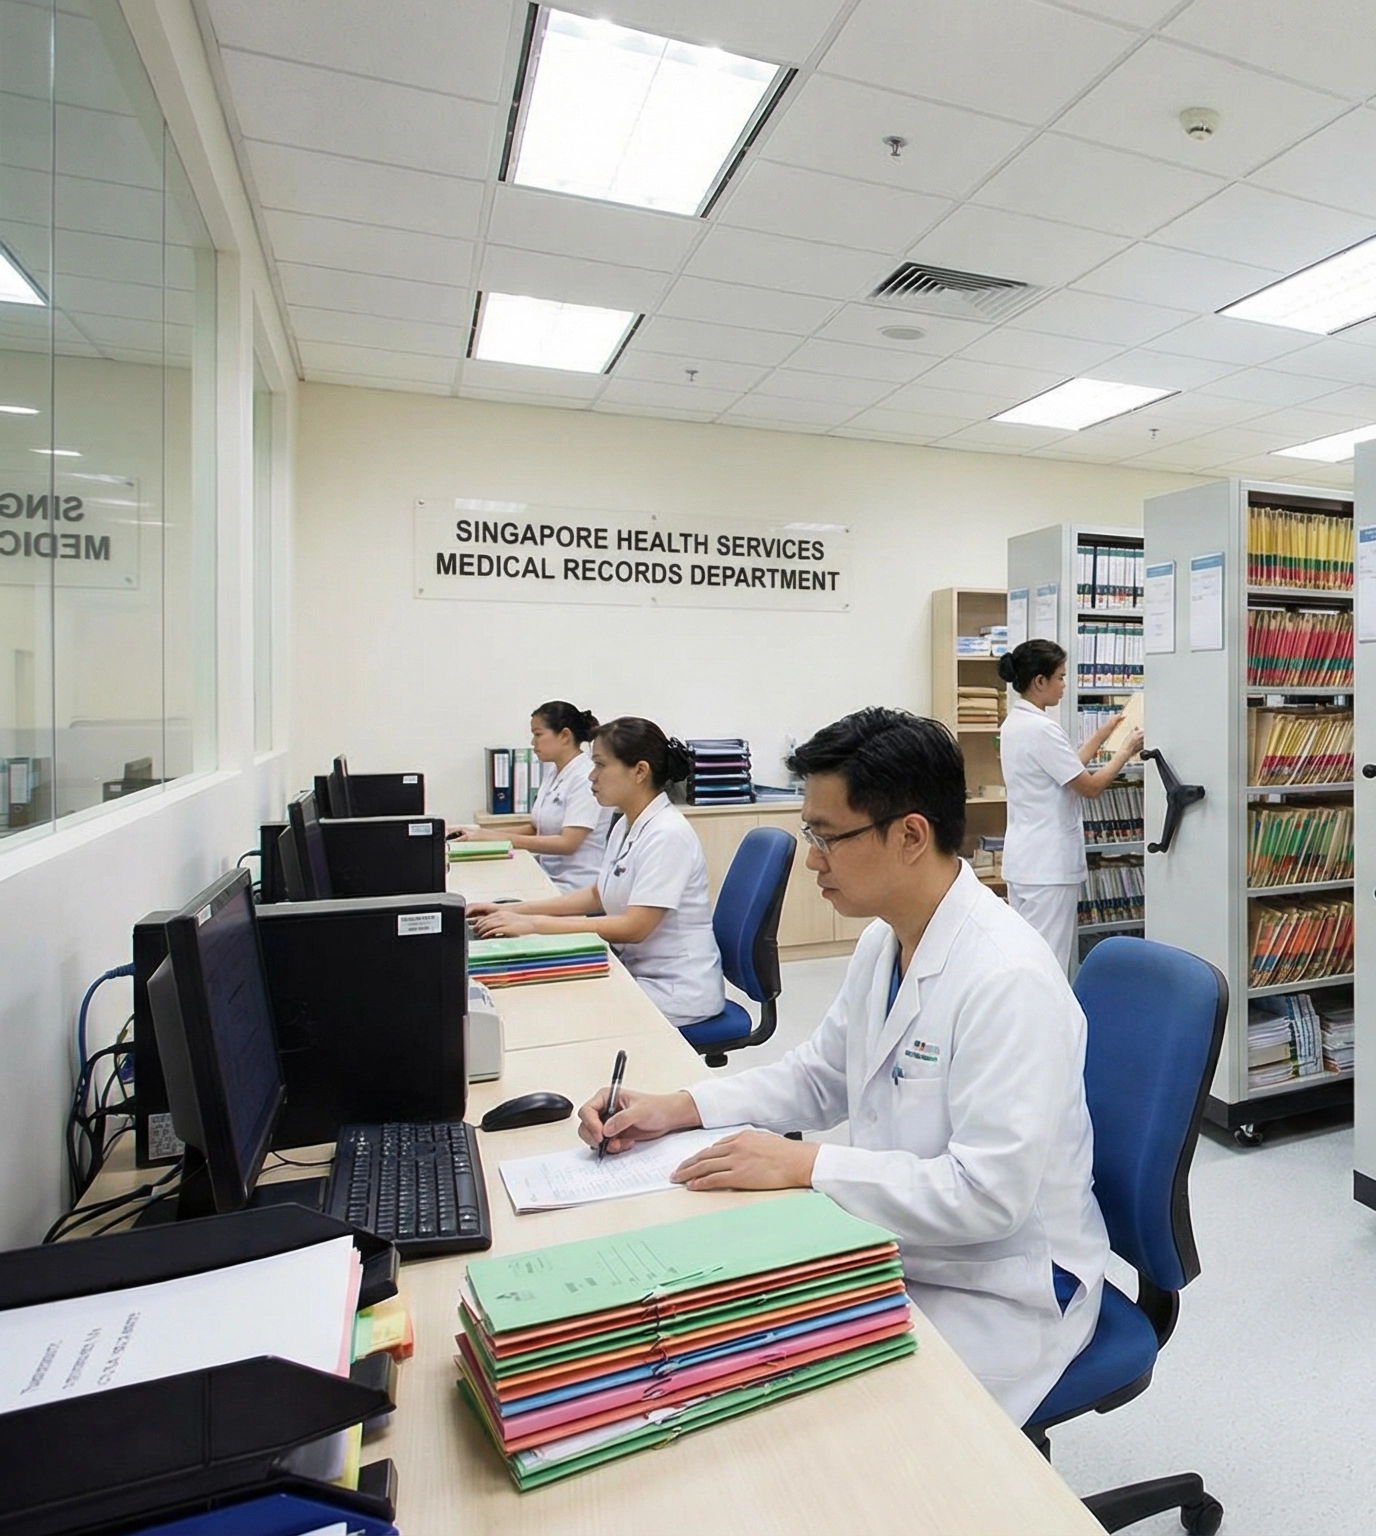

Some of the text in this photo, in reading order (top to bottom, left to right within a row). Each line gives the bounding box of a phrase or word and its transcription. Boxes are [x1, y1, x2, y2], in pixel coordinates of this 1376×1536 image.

[456, 520, 825, 560] SINGAPORE HEALTH SERVICES
[436, 553, 840, 591] MEDICAL RECORDS DEPARTMENT
